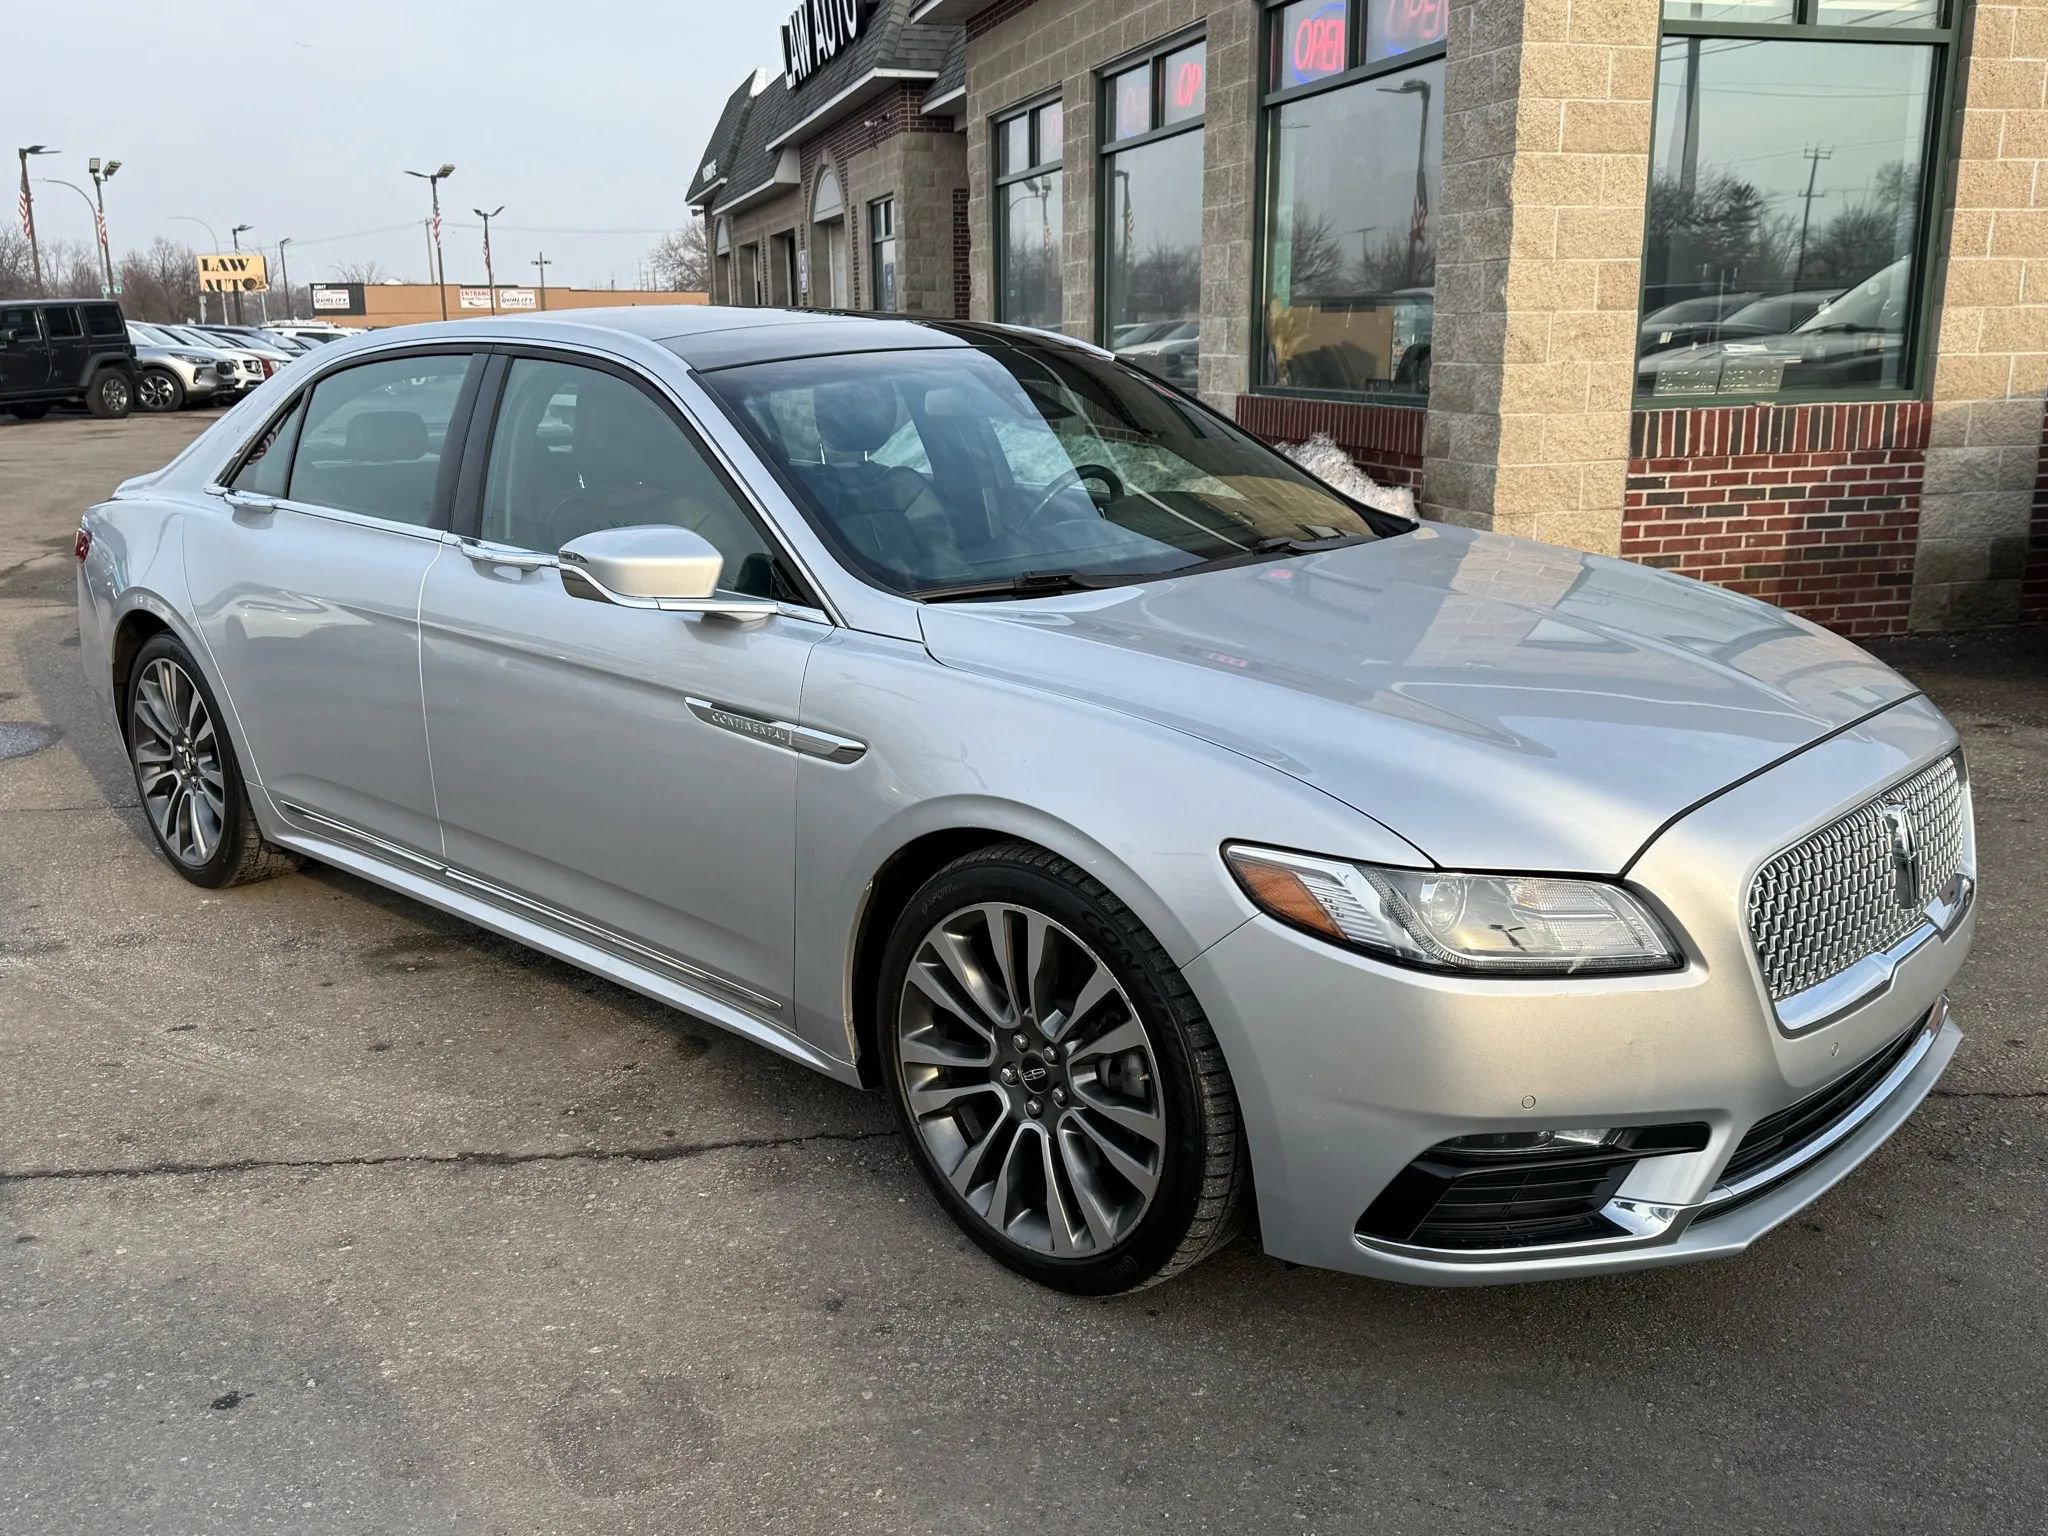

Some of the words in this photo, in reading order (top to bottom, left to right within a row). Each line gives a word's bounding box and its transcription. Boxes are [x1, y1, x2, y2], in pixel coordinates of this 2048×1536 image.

[780, 1, 811, 91] LAW
[201, 258, 250, 272] LAW
[712, 712, 785, 741] CONTINENTAL
